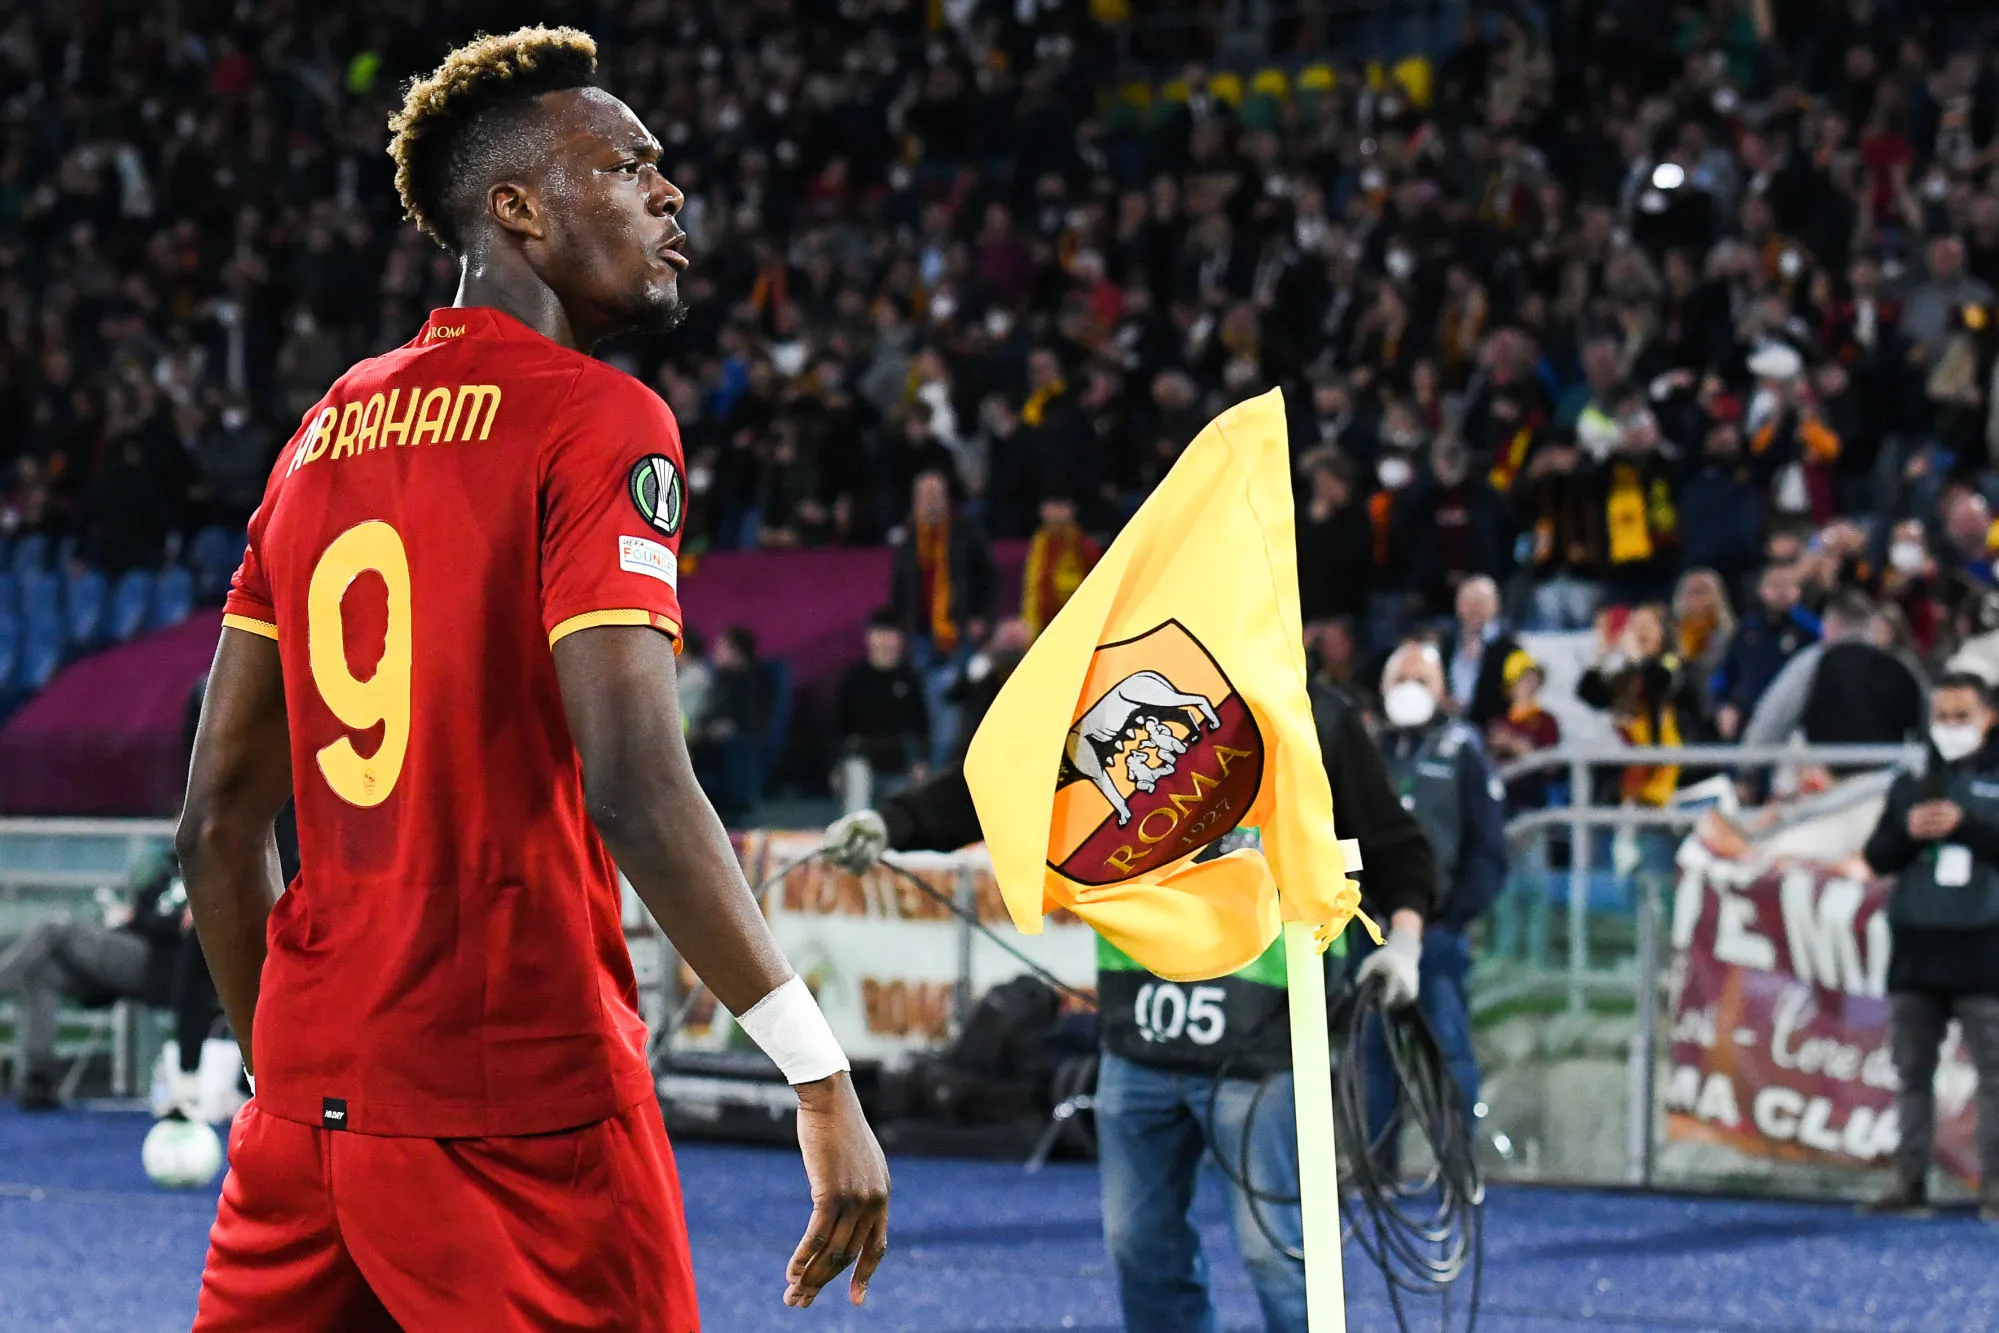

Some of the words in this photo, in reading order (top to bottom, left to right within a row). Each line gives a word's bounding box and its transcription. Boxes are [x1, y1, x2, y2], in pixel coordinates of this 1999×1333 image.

[286, 384, 502, 479] ABRAHAM
[624, 547, 675, 570] FOUNDA
[308, 519, 412, 808] 9
[1103, 745, 1252, 876] ROMA
[1181, 797, 1232, 845] 1927
